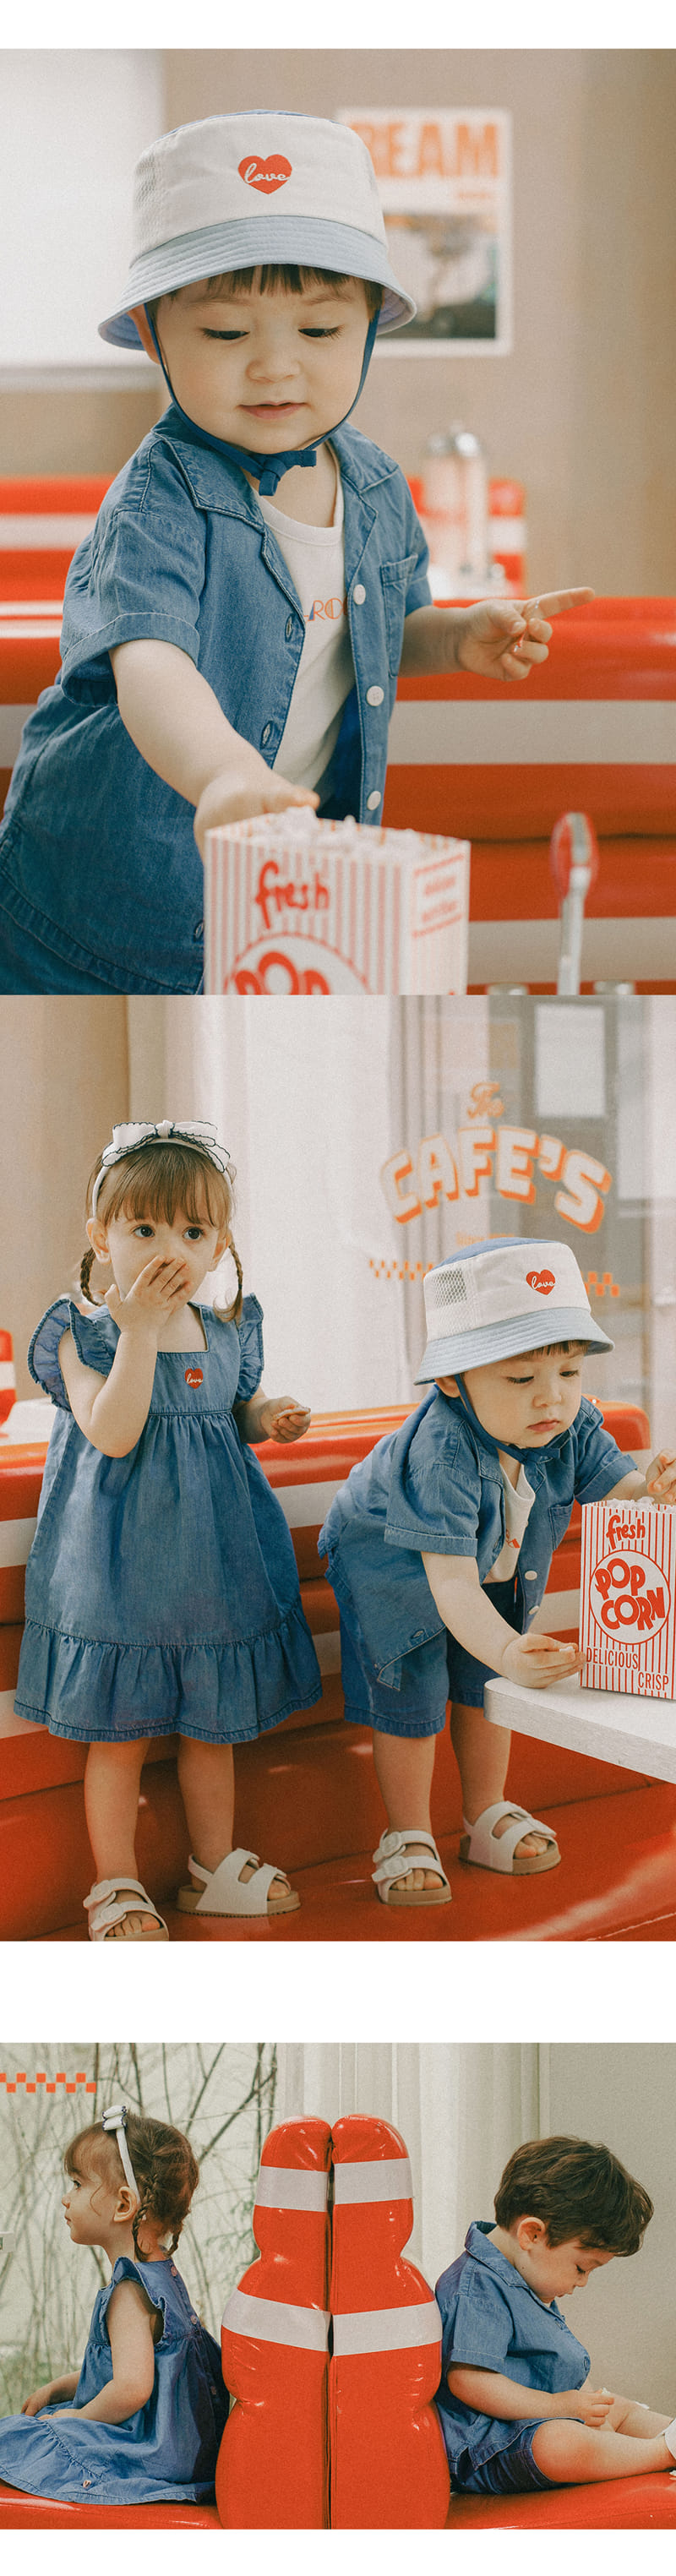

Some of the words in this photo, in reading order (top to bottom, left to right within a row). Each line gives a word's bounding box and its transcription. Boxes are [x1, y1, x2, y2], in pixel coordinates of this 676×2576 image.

[243, 162, 291, 183] love
[254, 860, 330, 929] fresh
[380, 1125, 613, 1234] CAFE'S
[532, 1275, 555, 1290] love
[186, 1372, 204, 1384] love
[606, 1514, 646, 1550] fresh
[594, 1558, 646, 1601] POP
[601, 1586, 666, 1631] CORN
[586, 1647, 639, 1669] DELICIOUS
[637, 1671, 669, 1691] CRISP
